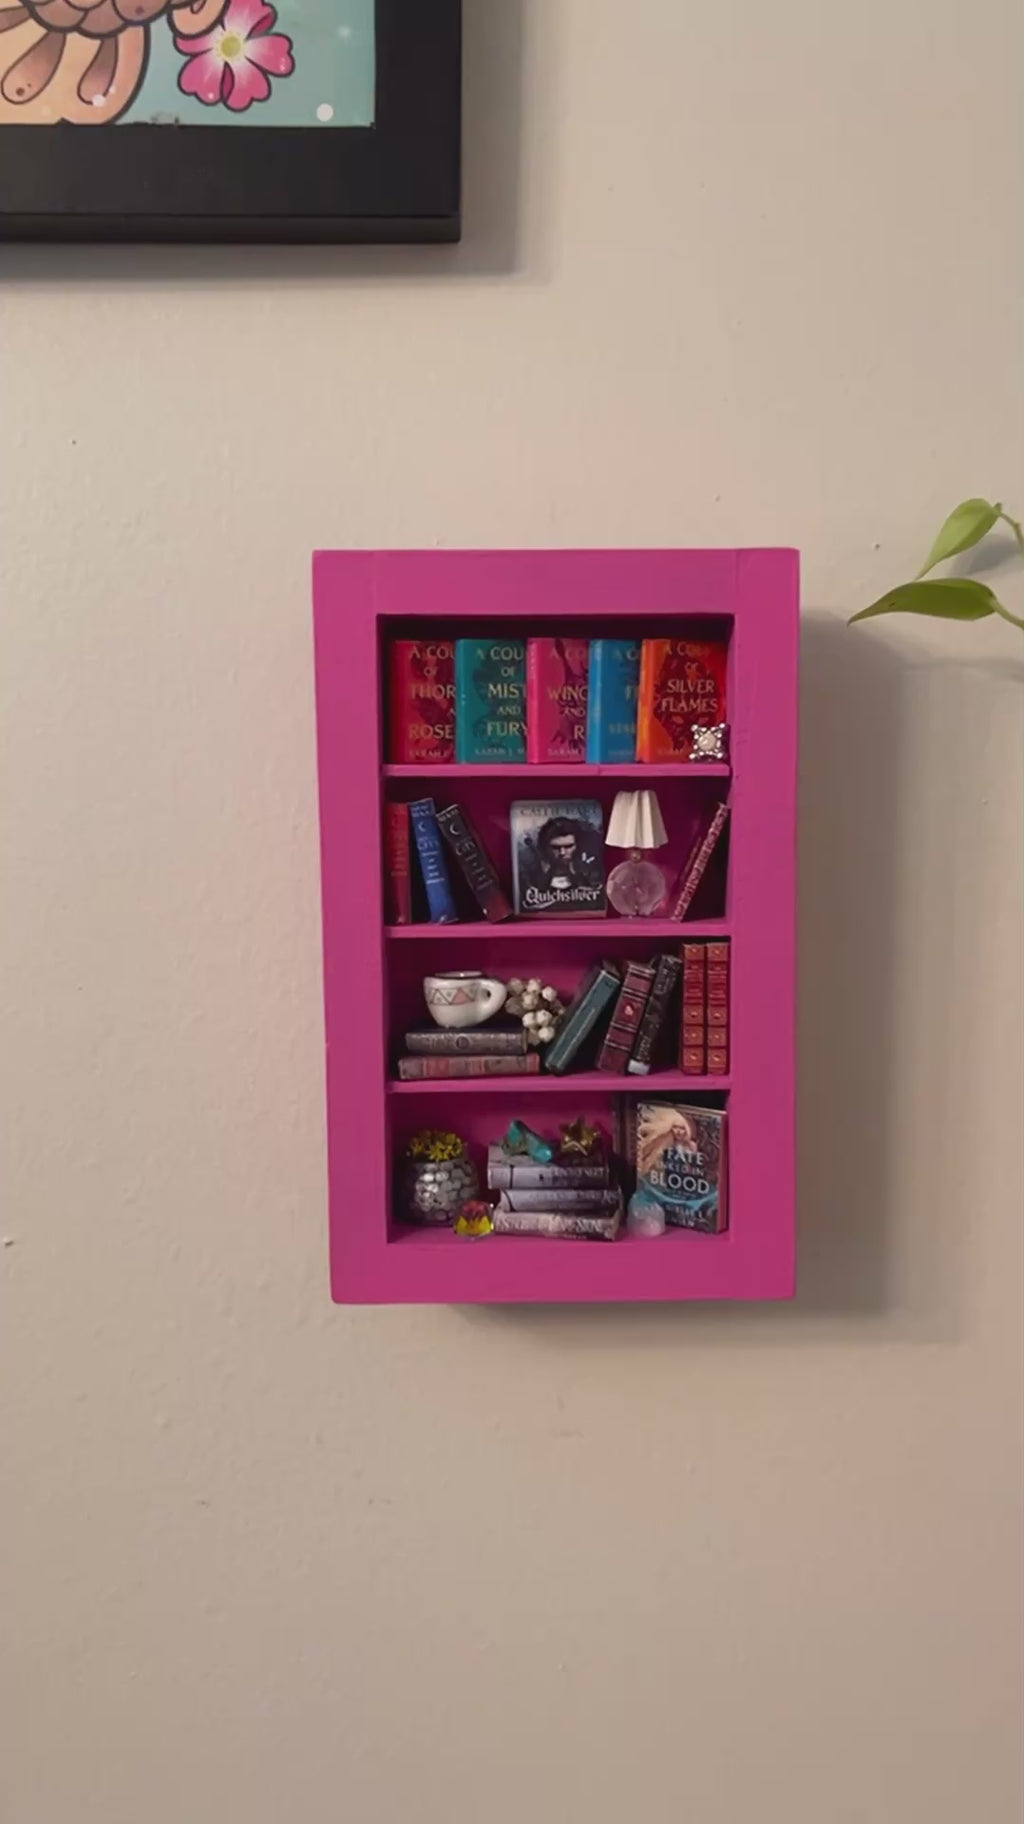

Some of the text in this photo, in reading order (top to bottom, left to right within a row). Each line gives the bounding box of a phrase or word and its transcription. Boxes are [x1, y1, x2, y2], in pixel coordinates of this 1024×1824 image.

[424, 666, 439, 677] OF
[501, 666, 515, 677] OF
[666, 679, 715, 693] SILVER
[497, 706, 522, 715] AND
[563, 706, 586, 717] AND
[661, 698, 718, 713] FLAMES
[522, 884, 603, 909] Quicksilver
[667, 1145, 704, 1165] FATE
[650, 1169, 710, 1195] BLOOD
